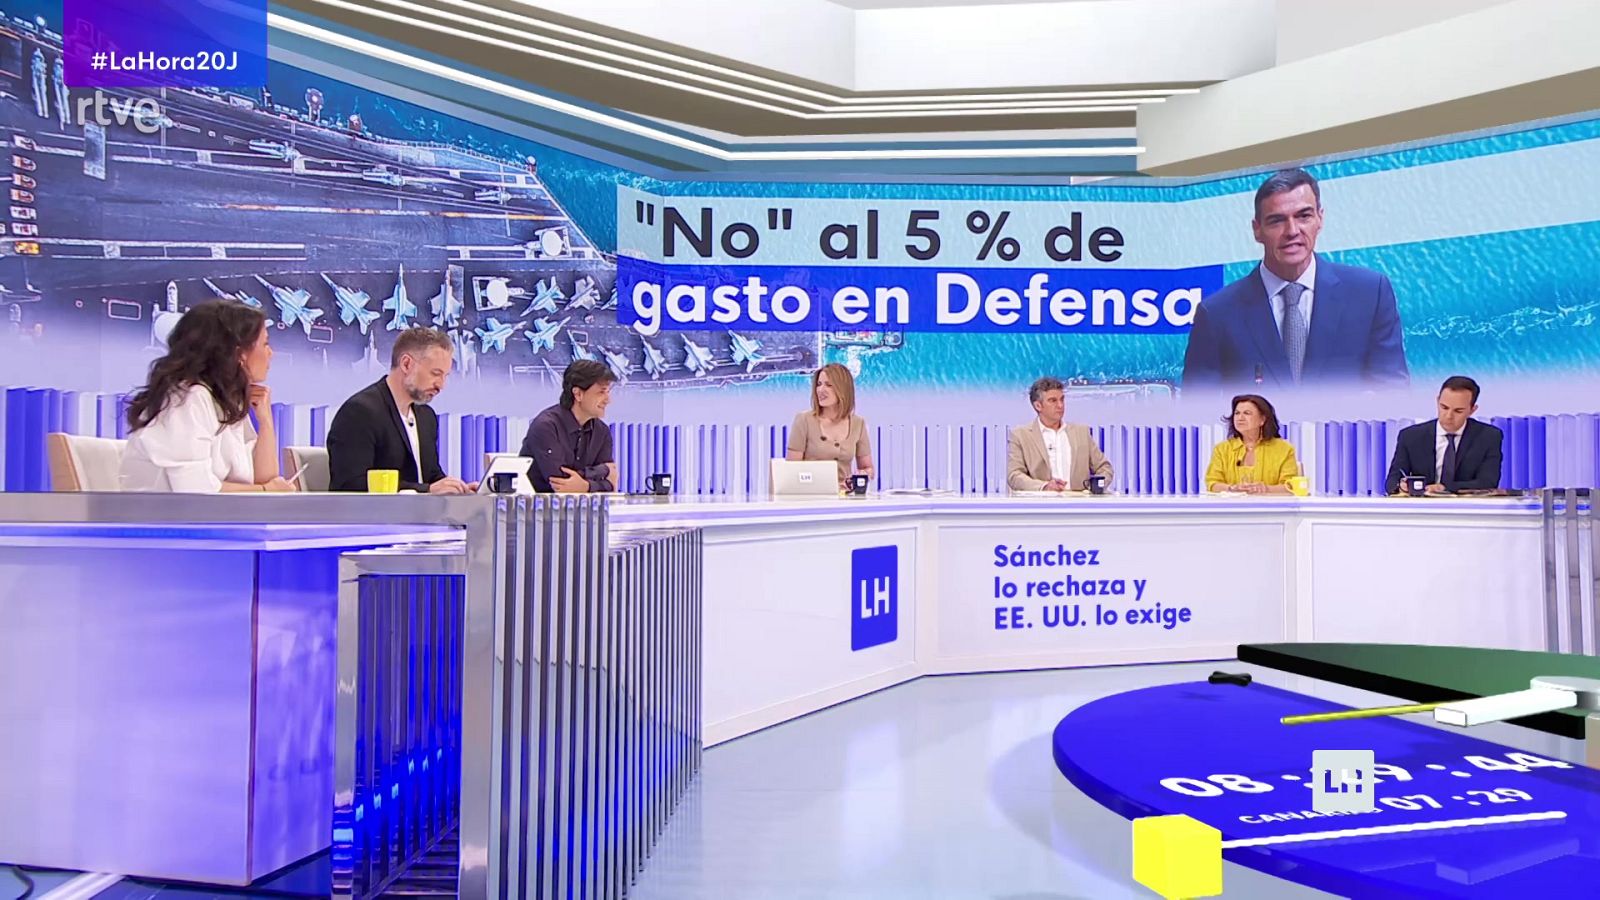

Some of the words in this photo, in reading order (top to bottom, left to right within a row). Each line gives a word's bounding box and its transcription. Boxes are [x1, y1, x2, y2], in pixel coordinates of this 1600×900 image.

[635, 201, 792, 258] "No"
[819, 209, 878, 260] al
[905, 210, 941, 261] 5
[966, 210, 1021, 262] %
[1044, 212, 1125, 263] de
[632, 276, 811, 335] gasto
[832, 286, 909, 325] en
[937, 272, 1202, 326] Defensa
[993, 544, 1100, 567] Sánchez
[861, 576, 890, 619] LH
[994, 576, 1018, 598] lo
[1027, 575, 1126, 597] rechaza
[1133, 579, 1147, 601] y
[994, 607, 1033, 630] EE.
[1042, 605, 1087, 627] UU.
[1096, 604, 1118, 625] lo
[1125, 602, 1192, 630] exige
[1160, 774, 1274, 797] 08
[1379, 794, 1443, 811] 07
